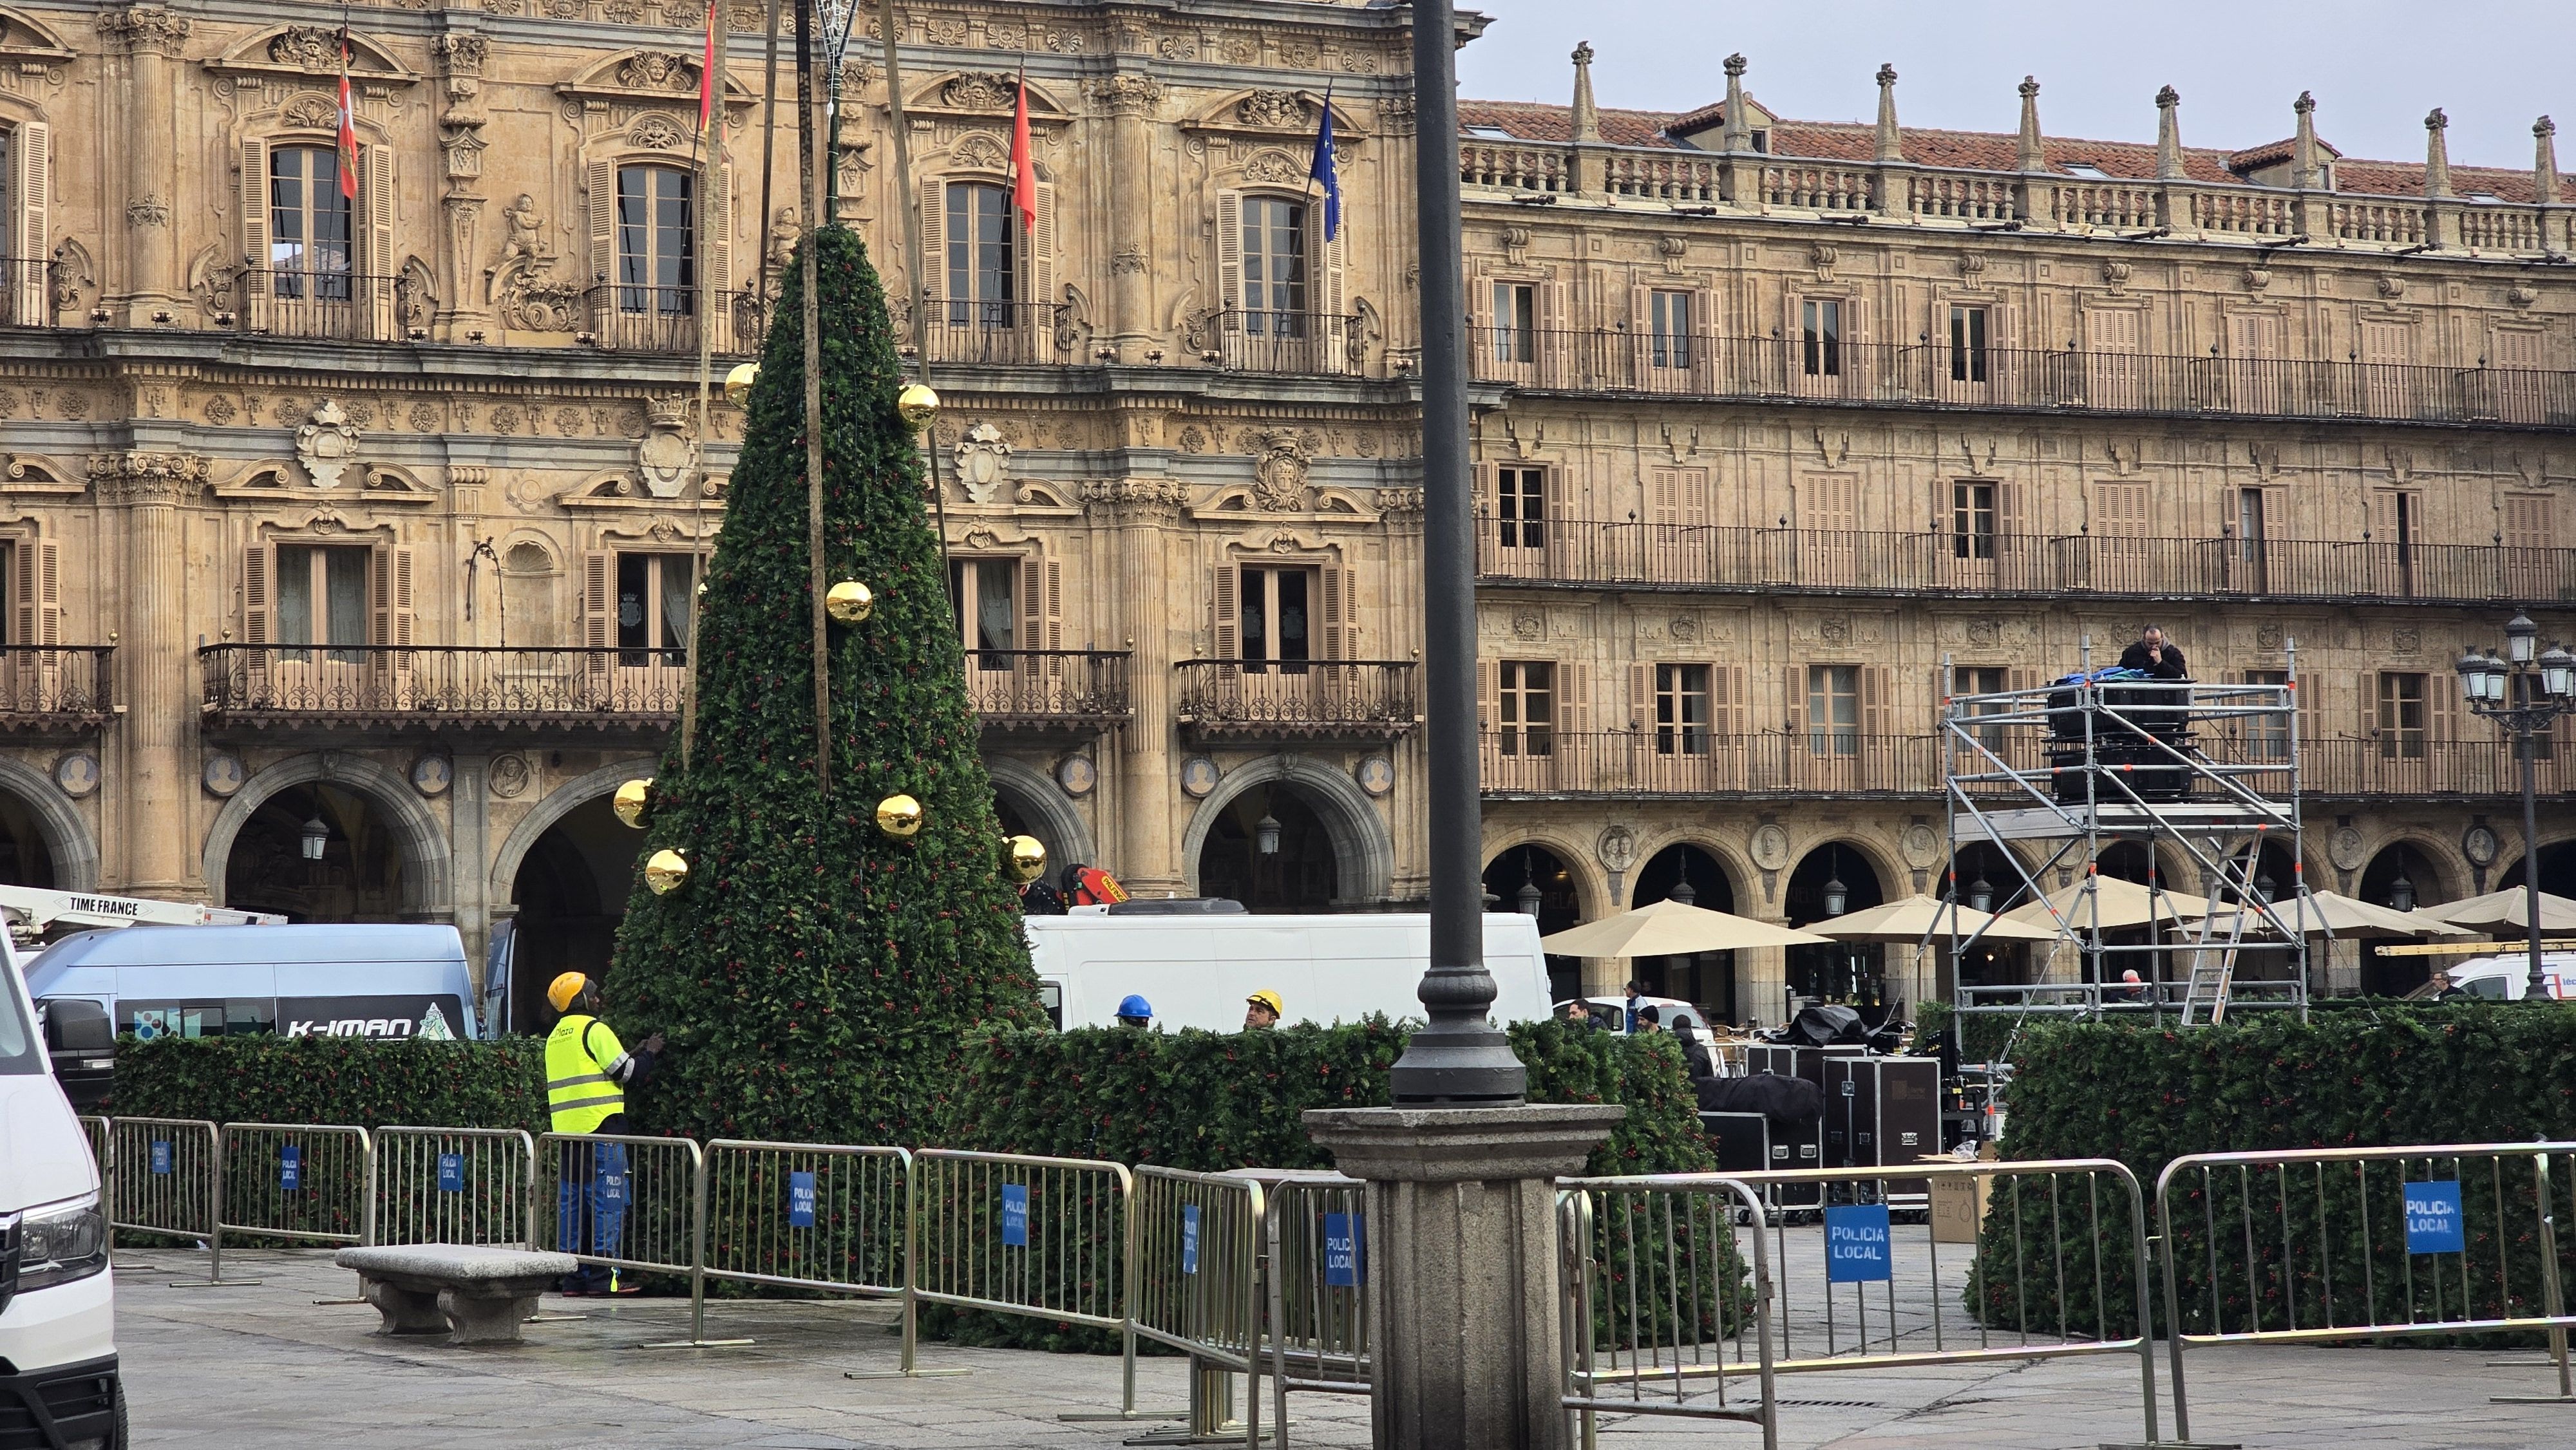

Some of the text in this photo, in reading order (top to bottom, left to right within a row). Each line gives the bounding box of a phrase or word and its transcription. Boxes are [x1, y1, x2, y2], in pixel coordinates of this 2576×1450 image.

[70, 897, 138, 916] TIME FRANCE
[287, 1019, 412, 1038] K-IMAN
[795, 1201, 813, 1213] LOCAL
[2406, 1200, 2455, 1215] POLICIA
[2409, 1218, 2452, 1233] LOCAL
[1832, 1226, 1884, 1241] POLICIA
[1327, 1238, 1351, 1251] POLIC
[1834, 1245, 1882, 1260] LOCAL
